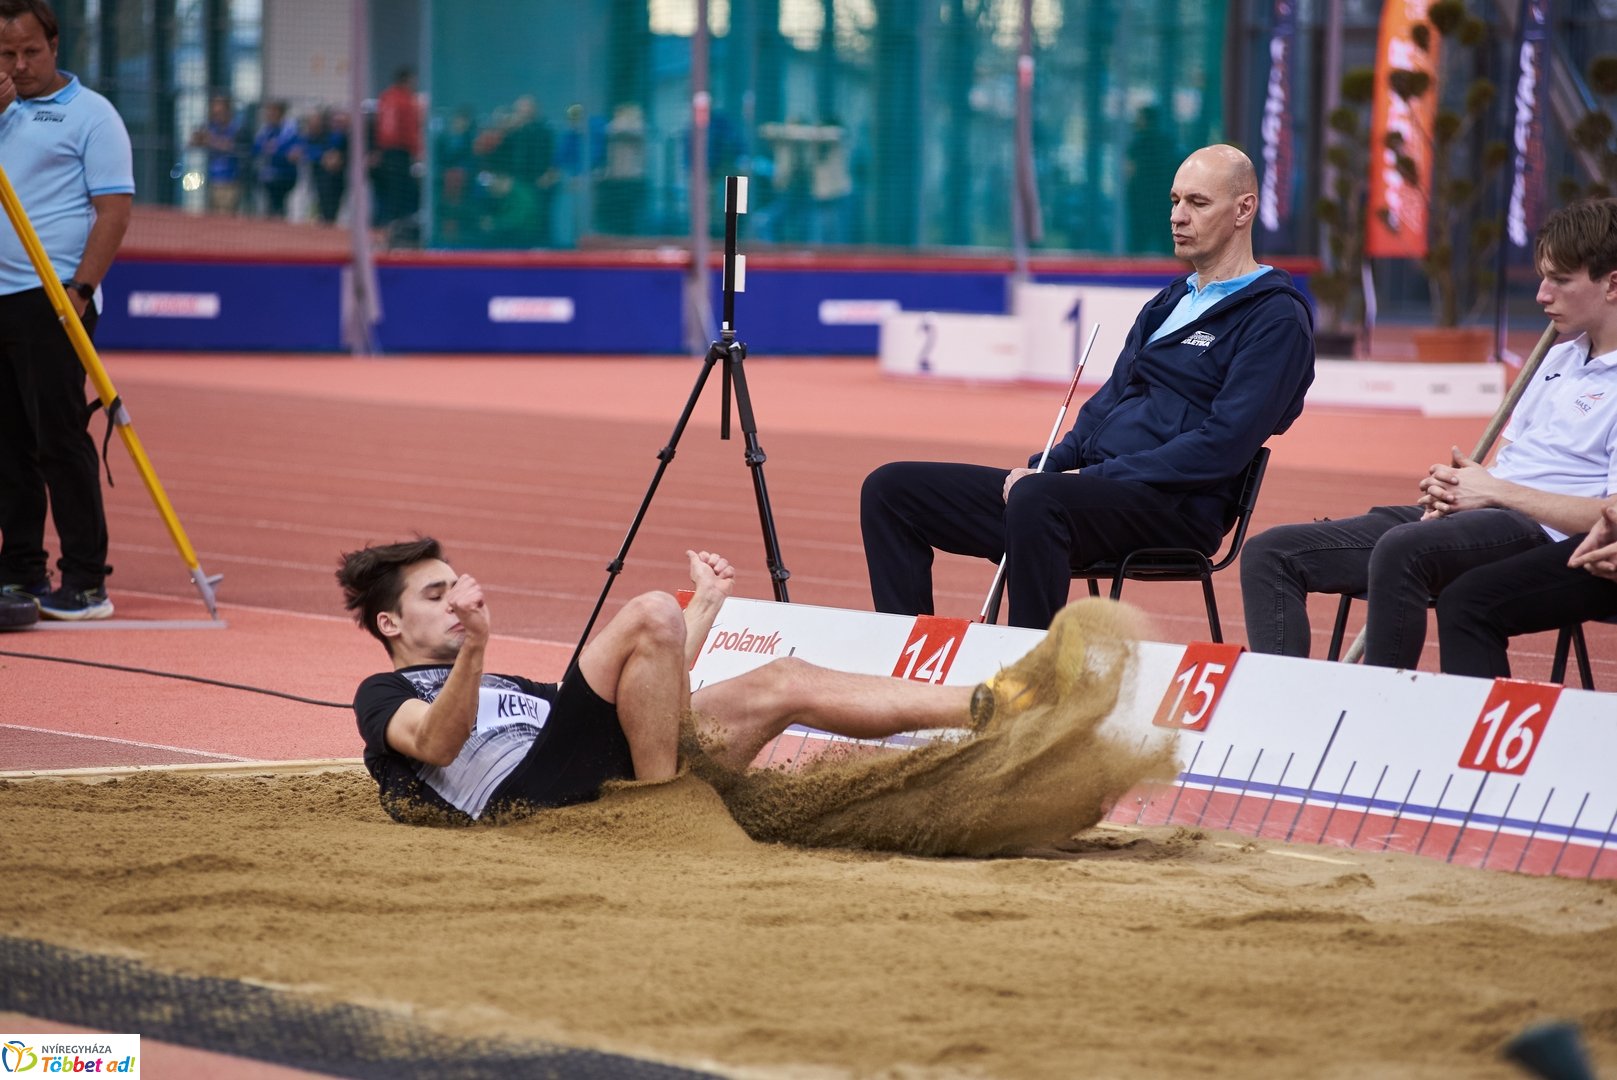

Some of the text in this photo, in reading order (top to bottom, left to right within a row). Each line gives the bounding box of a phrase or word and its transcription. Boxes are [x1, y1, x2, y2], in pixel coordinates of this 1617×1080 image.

[918, 317, 937, 371] 2
[1574, 399, 1592, 412] MASZ
[707, 627, 783, 655] polanik
[904, 633, 956, 685] 14
[1168, 662, 1226, 725] 15
[1473, 700, 1541, 769] 16
